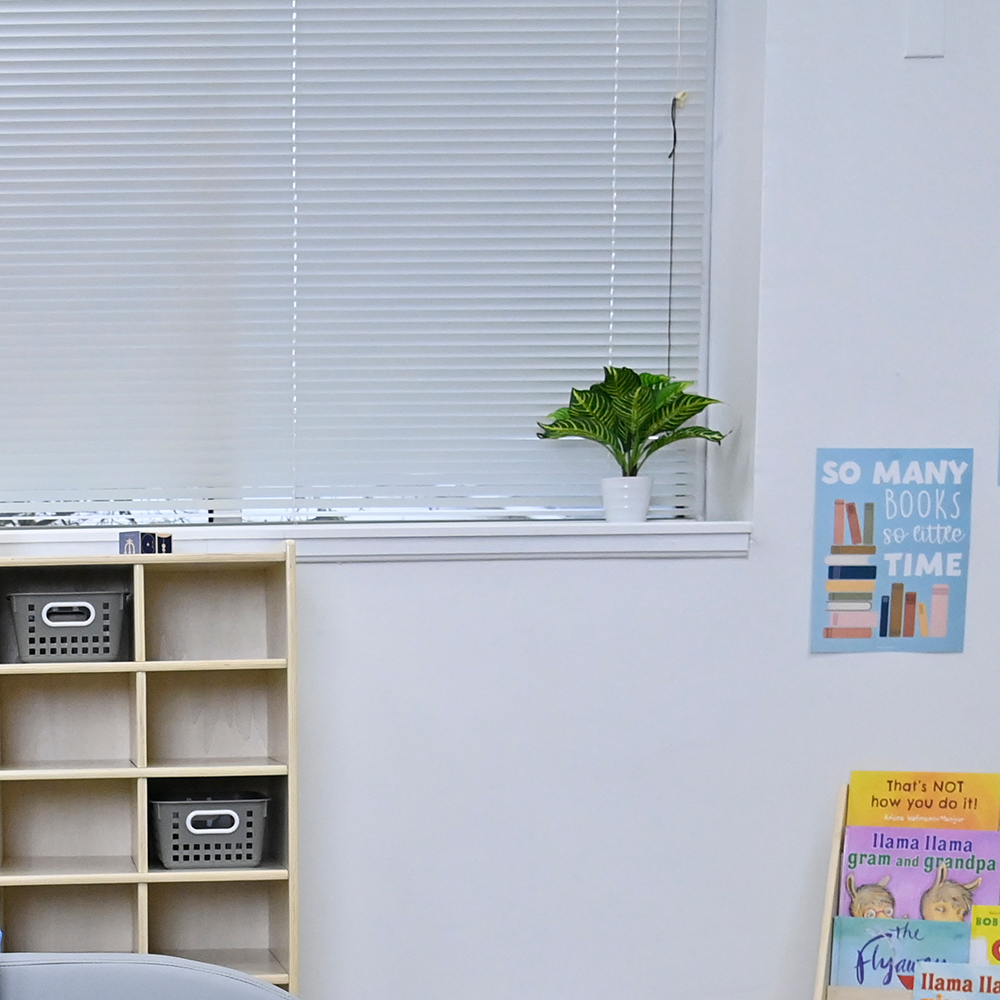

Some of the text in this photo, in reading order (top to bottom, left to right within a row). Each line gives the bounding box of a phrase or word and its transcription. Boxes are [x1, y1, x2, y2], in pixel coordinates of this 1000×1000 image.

[821, 459, 969, 485] SO MANY
[885, 488, 961, 520] BOOKS
[883, 524, 966, 545] so little
[883, 552, 963, 577] TIME
[887, 779, 965, 793] That's NOT
[871, 795, 978, 811] how you do it!
[872, 833, 973, 853] llama llama
[847, 852, 996, 874] gram and grandpa
[889, 922, 925, 942] the
[975, 917, 999, 927] BOB
[854, 932, 947, 986] Flyaw
[921, 972, 973, 994] llama
